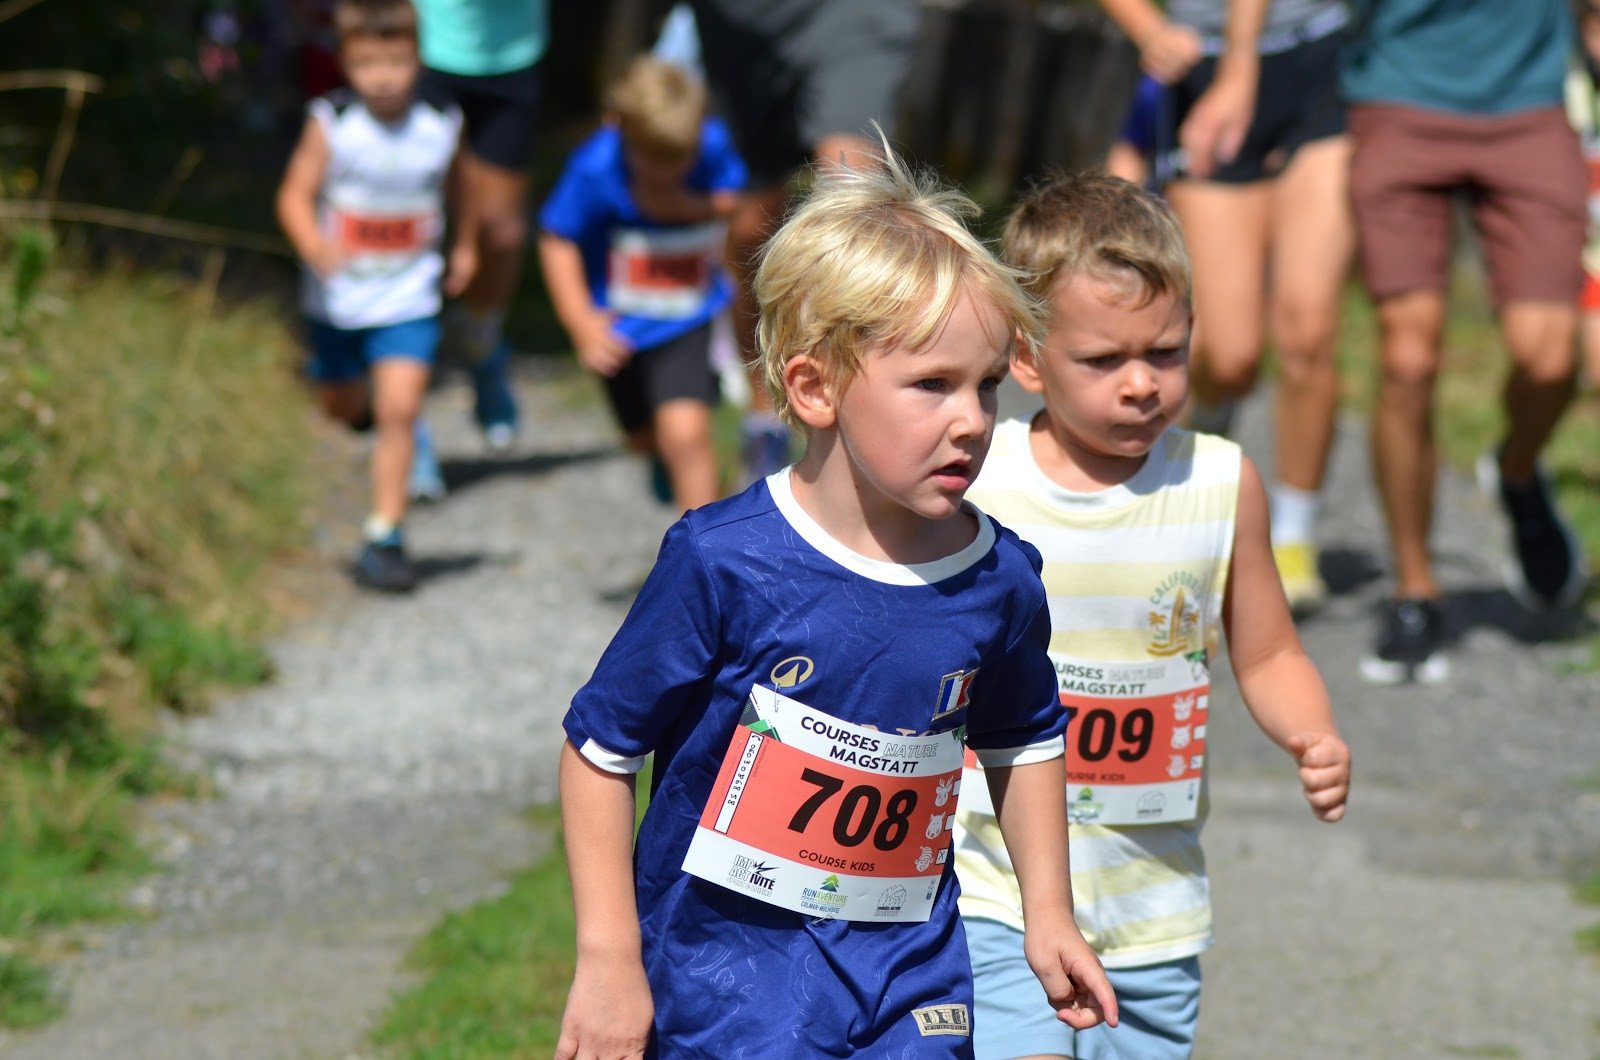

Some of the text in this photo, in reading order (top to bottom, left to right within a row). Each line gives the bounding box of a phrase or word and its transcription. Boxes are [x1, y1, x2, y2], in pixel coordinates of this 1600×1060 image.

[1055, 662, 1103, 679] URSES
[1061, 679, 1145, 694] MAGSTATT
[801, 716, 880, 752] COURSES
[883, 742, 939, 758] NATURE
[1063, 706, 1154, 763] 09
[829, 745, 918, 774] MAGSTATT
[787, 767, 918, 851] 708
[799, 849, 875, 872] COURSE KIDS
